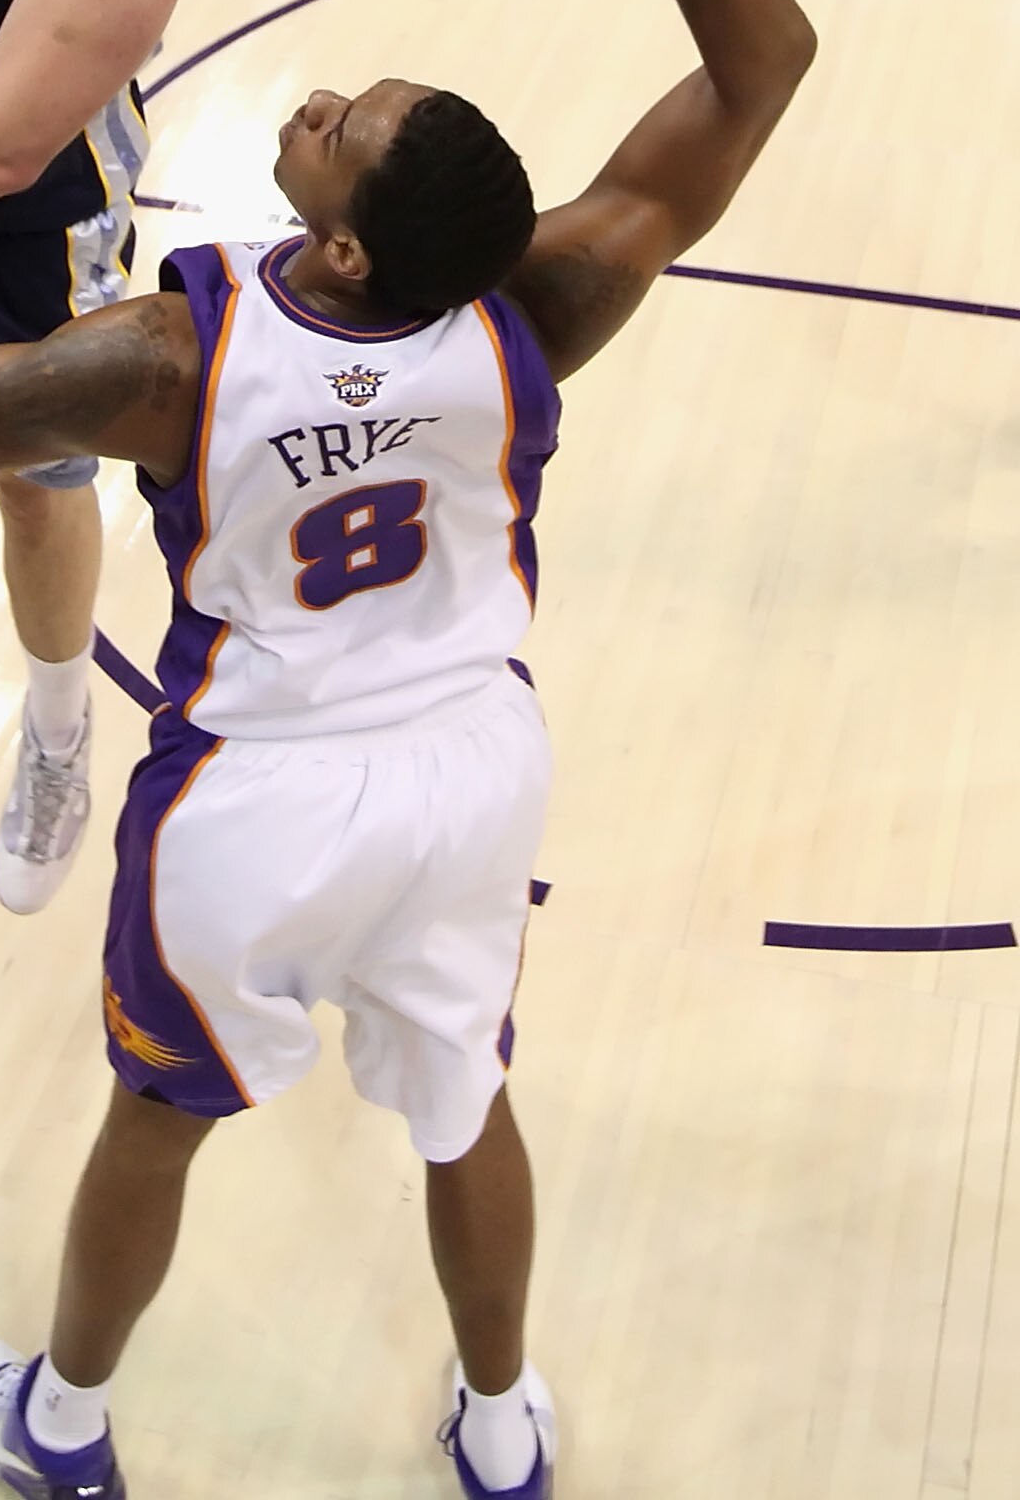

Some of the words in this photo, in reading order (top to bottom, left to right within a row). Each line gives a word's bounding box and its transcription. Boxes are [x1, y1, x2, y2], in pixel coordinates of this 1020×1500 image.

[340, 382, 376, 398] PHX
[267, 416, 443, 489] FRYE
[289, 478, 428, 611] 8
